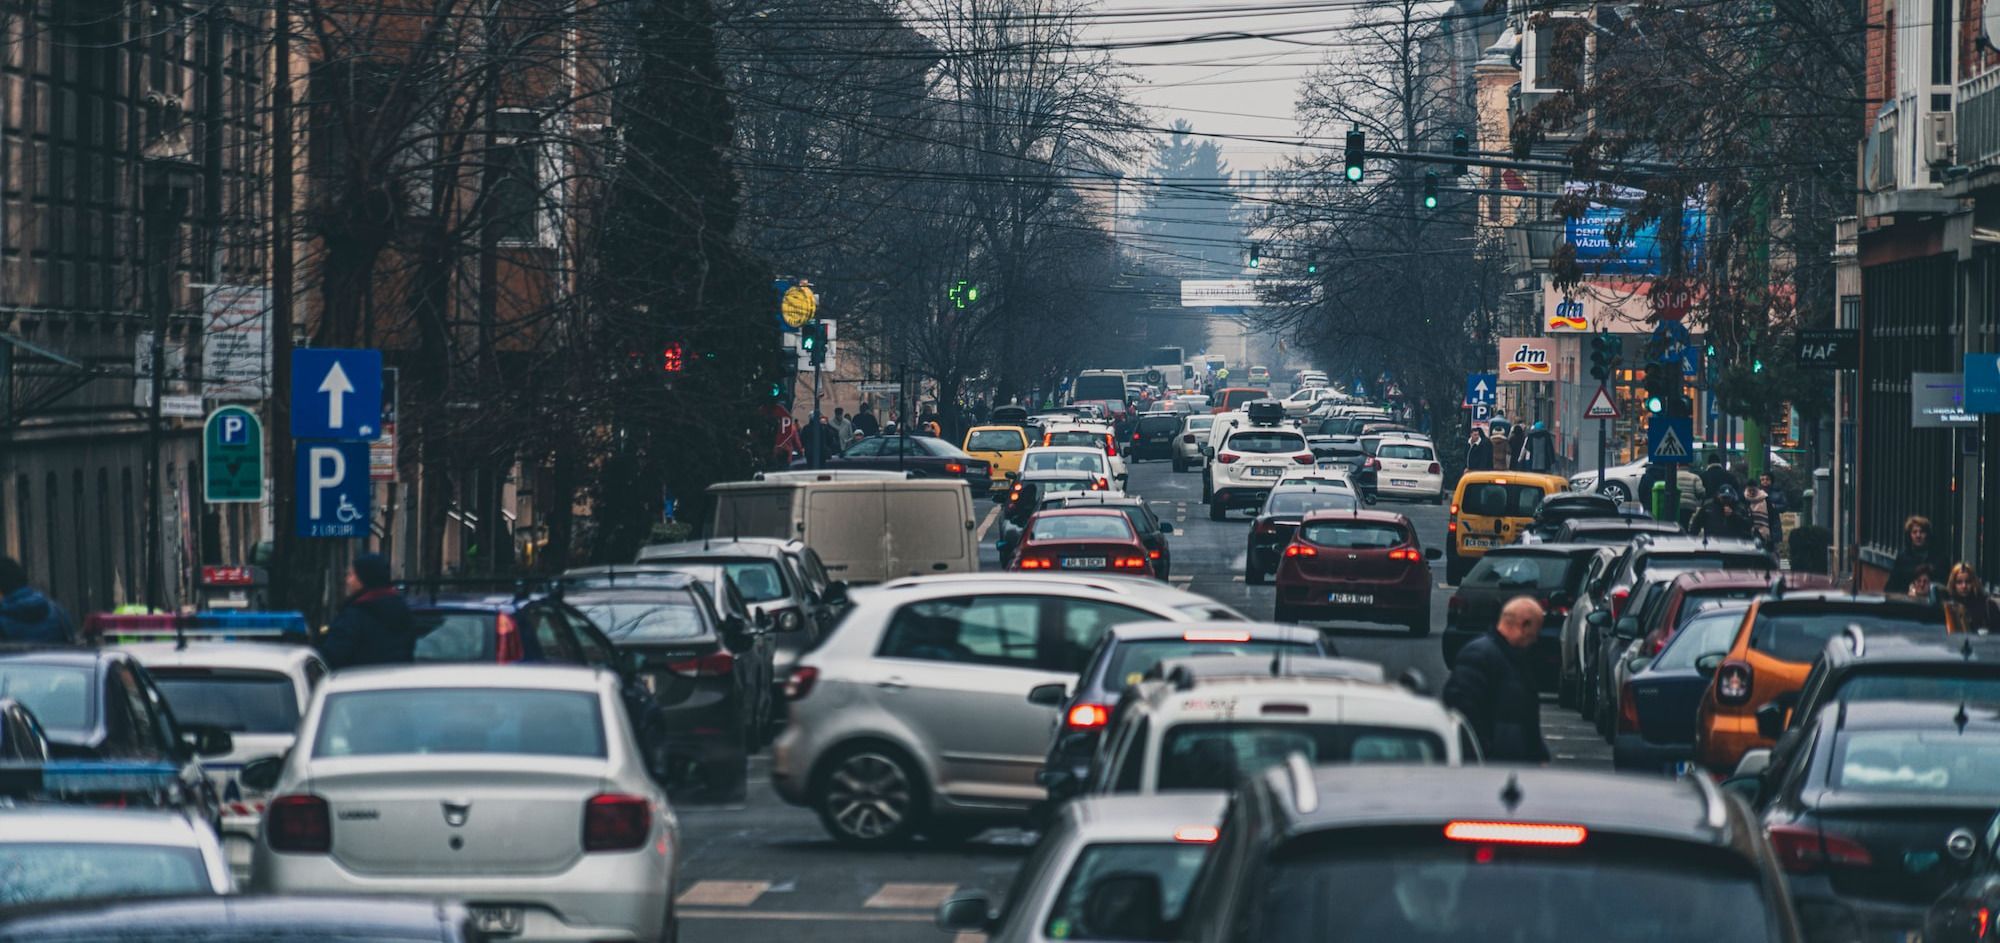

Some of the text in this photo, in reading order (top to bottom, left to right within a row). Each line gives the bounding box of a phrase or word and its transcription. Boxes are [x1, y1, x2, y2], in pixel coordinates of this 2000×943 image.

[1556, 299, 1584, 318] dm
[1515, 345, 1546, 363] dm
[1801, 343, 1838, 360] HAF
[1477, 406, 1488, 419] P
[225, 417, 243, 442] P
[782, 416, 791, 434] P
[309, 447, 346, 520] P
